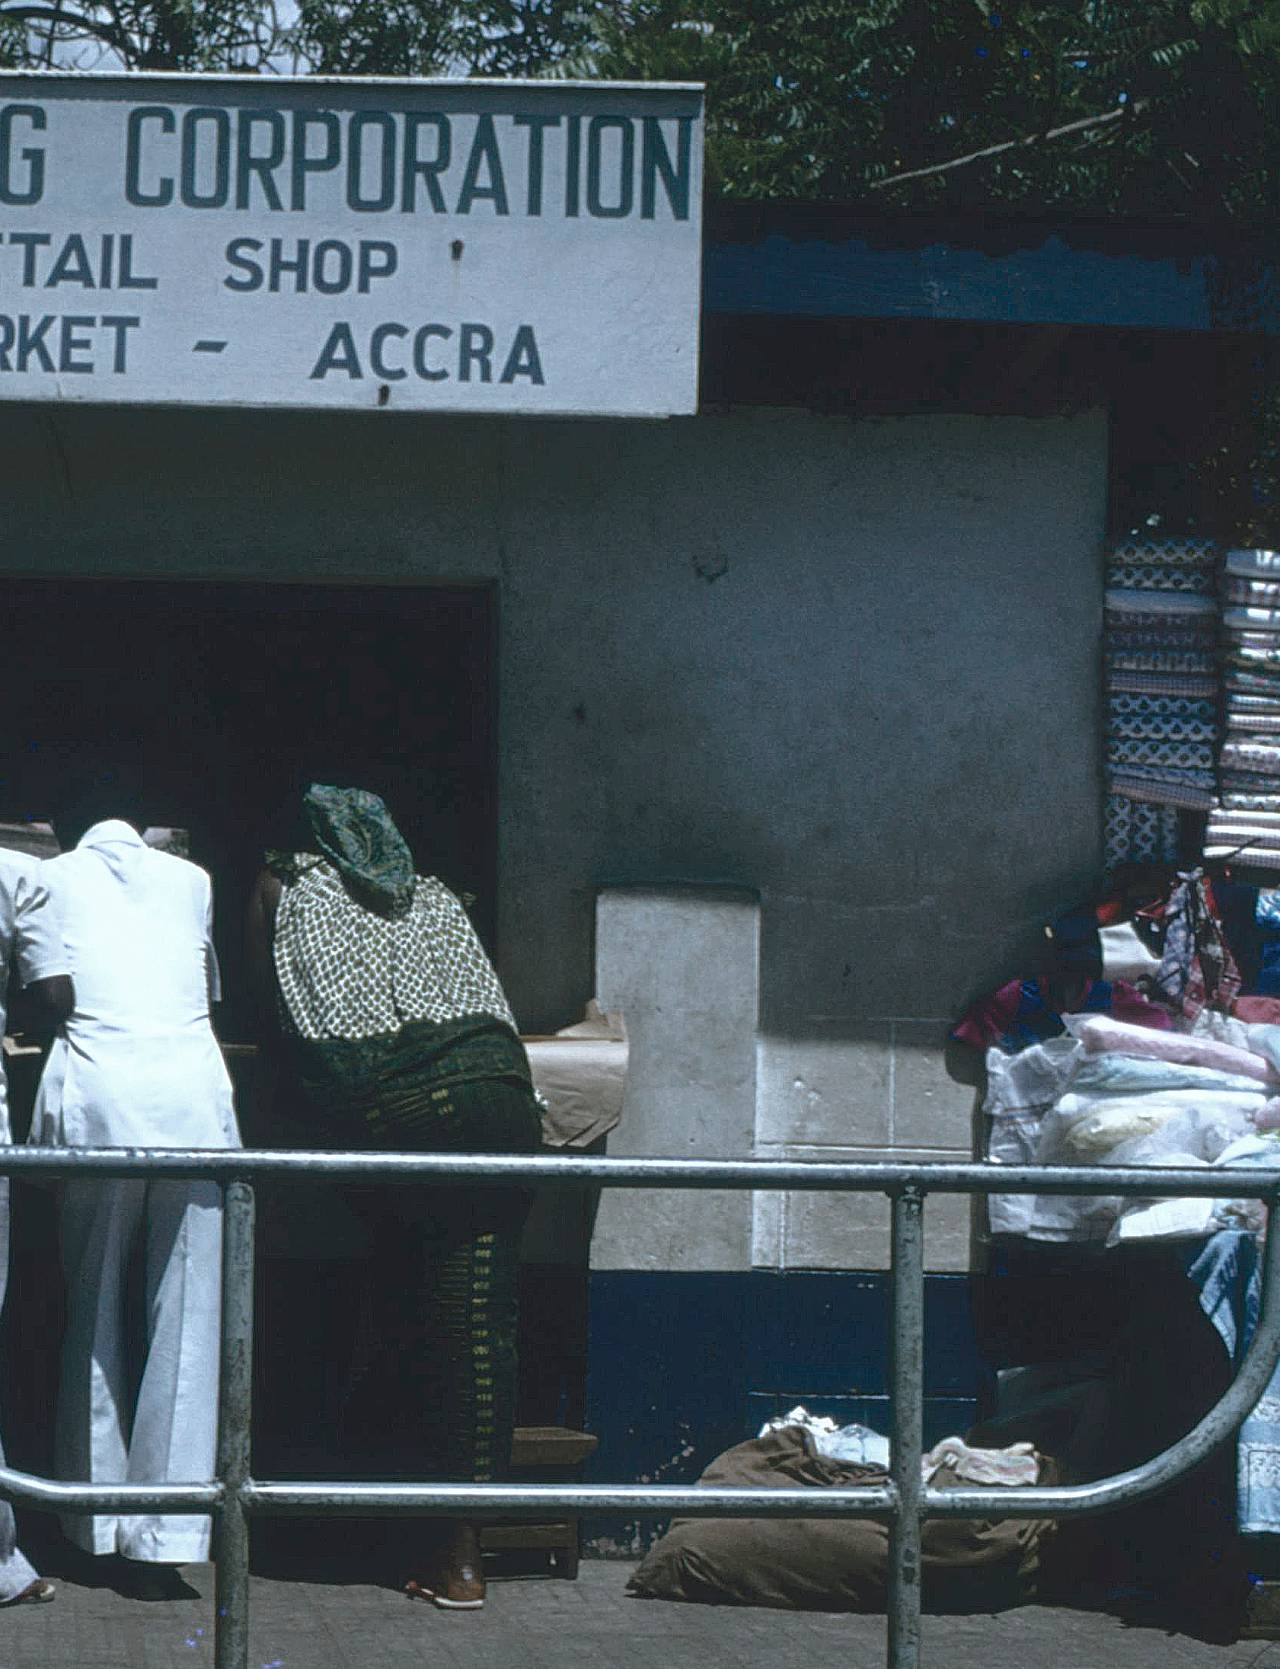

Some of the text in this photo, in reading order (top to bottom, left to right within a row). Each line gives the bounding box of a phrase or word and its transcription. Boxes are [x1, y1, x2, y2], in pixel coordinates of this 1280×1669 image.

[124, 105, 692, 221] CORPORATION
[223, 236, 399, 295] SHOP
[309, 321, 546, 386] ACCRA
